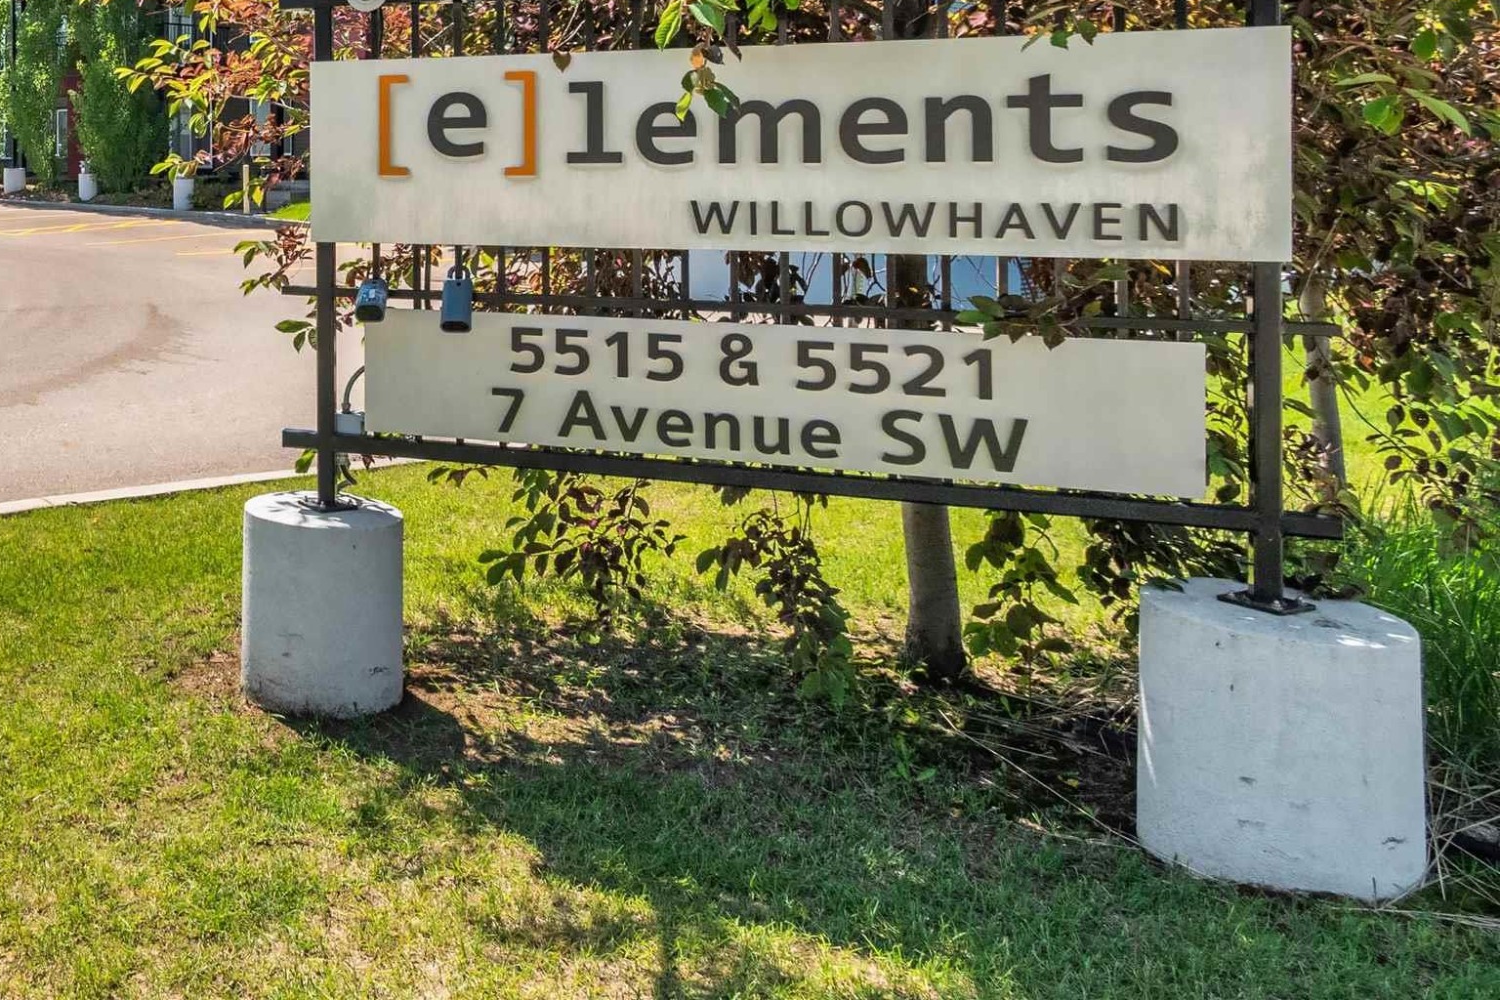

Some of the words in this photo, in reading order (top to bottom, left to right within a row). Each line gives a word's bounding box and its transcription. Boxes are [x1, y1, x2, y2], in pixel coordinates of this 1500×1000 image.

[689, 200, 1180, 243] WILLOWHAVEN
[509, 326, 684, 382] 5515
[718, 332, 760, 387] &
[795, 339, 994, 401] 5521
[490, 386, 526, 434] 7
[556, 389, 842, 460] Avenue
[880, 408, 1029, 474] SW
